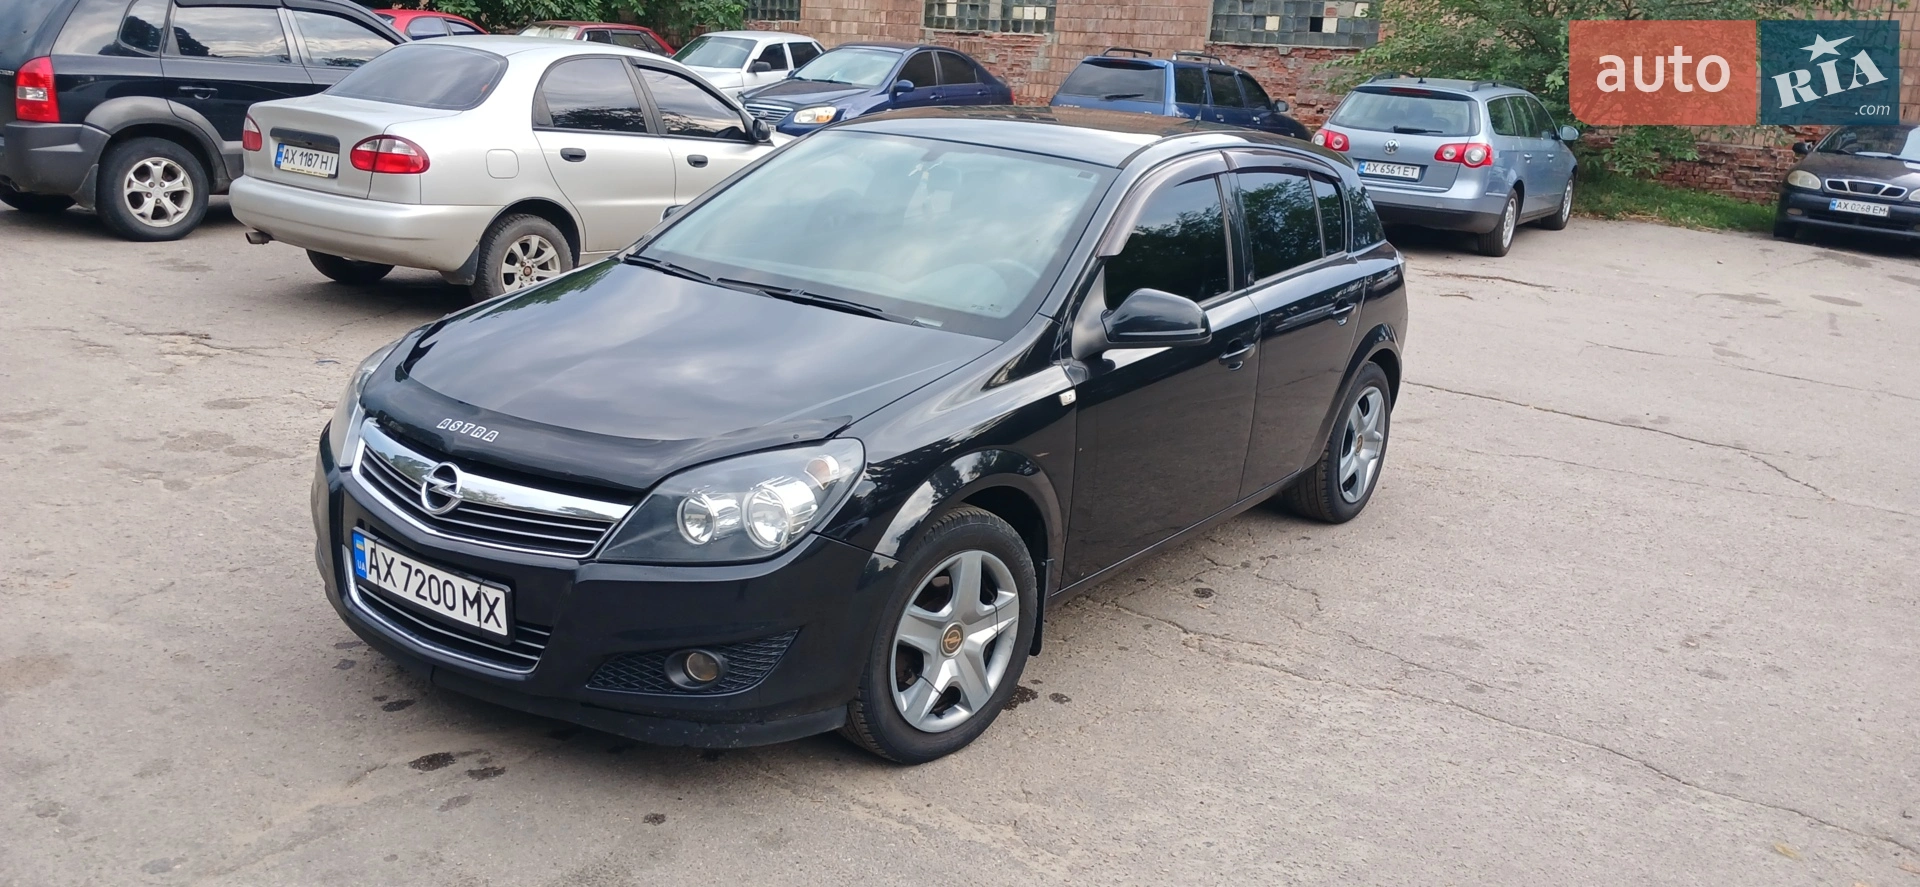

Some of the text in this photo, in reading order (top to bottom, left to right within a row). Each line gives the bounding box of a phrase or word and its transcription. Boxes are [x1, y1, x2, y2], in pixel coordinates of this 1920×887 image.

[283, 148, 334, 171] AX 1187 HI
[1365, 162, 1379, 173] AX
[1379, 164, 1401, 175] 6561
[1402, 166, 1418, 177] ET
[1836, 201, 1850, 210] AX
[1872, 205, 1887, 215] EM
[436, 418, 500, 443] ASTRA
[357, 559, 366, 572] UA
[368, 547, 503, 629] AX 7200 MX
